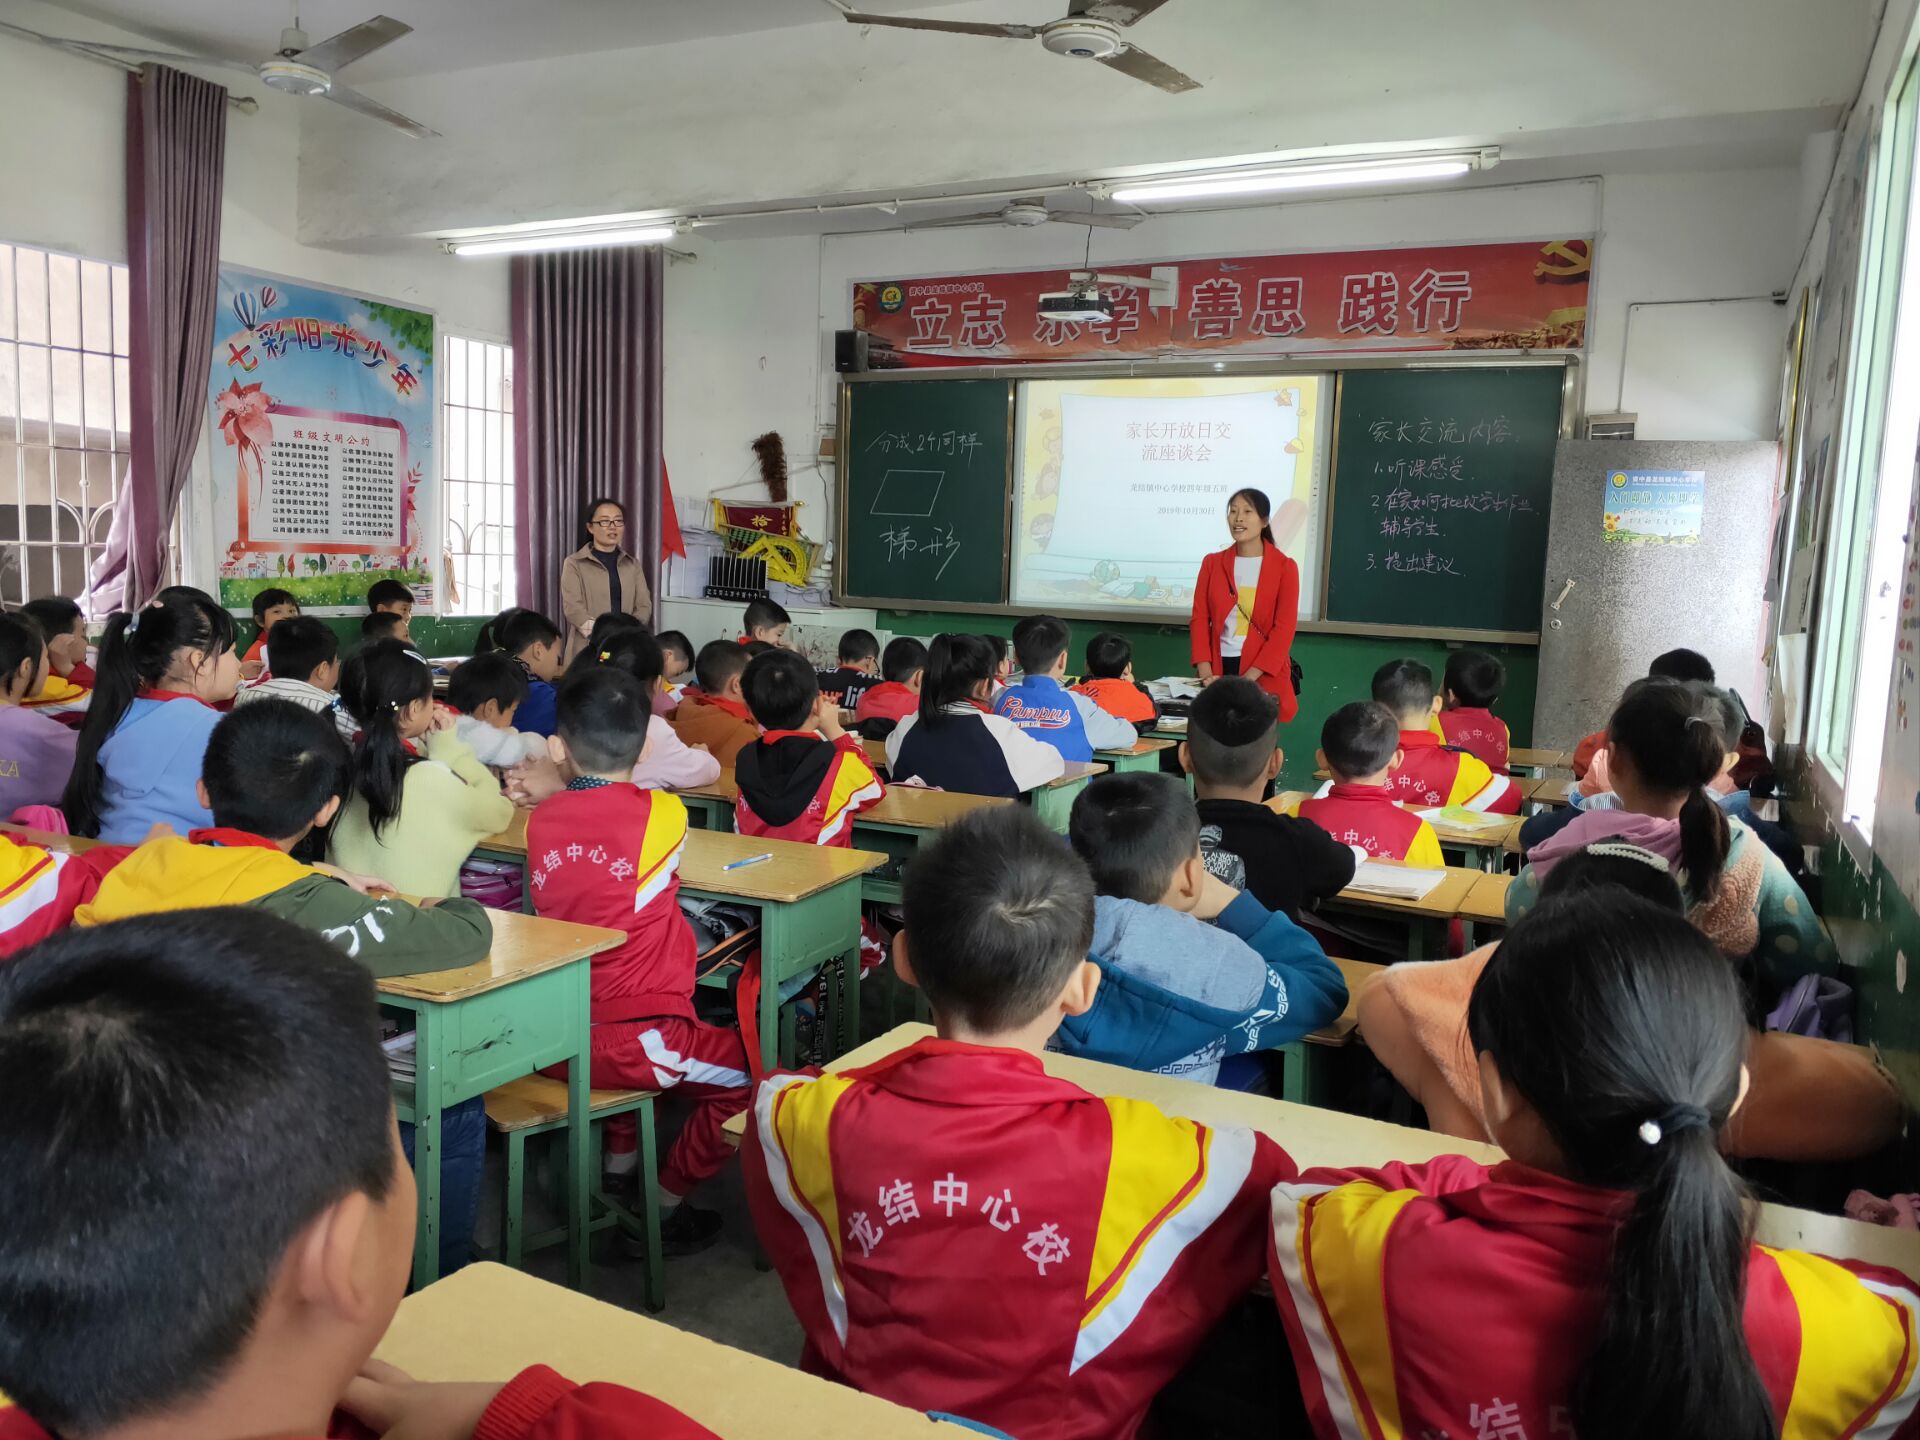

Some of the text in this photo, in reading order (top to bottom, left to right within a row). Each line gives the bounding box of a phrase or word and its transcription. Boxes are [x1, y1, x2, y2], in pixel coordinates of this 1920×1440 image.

[907, 293, 1006, 349] 立志
[1188, 276, 1306, 340] 善思
[1338, 267, 1471, 335] 践行
[227, 317, 417, 396] 七彩阳光少年
[293, 430, 370, 447] 班级文明公约
[1126, 421, 1232, 440] 家长开放日交
[1142, 443, 1212, 462] 流座谈会
[879, 522, 961, 581] 梯形
[1000, 696, 1070, 721] Campus
[531, 843, 634, 891] 龙结中心校
[848, 1172, 1071, 1276] 龙结中心校
